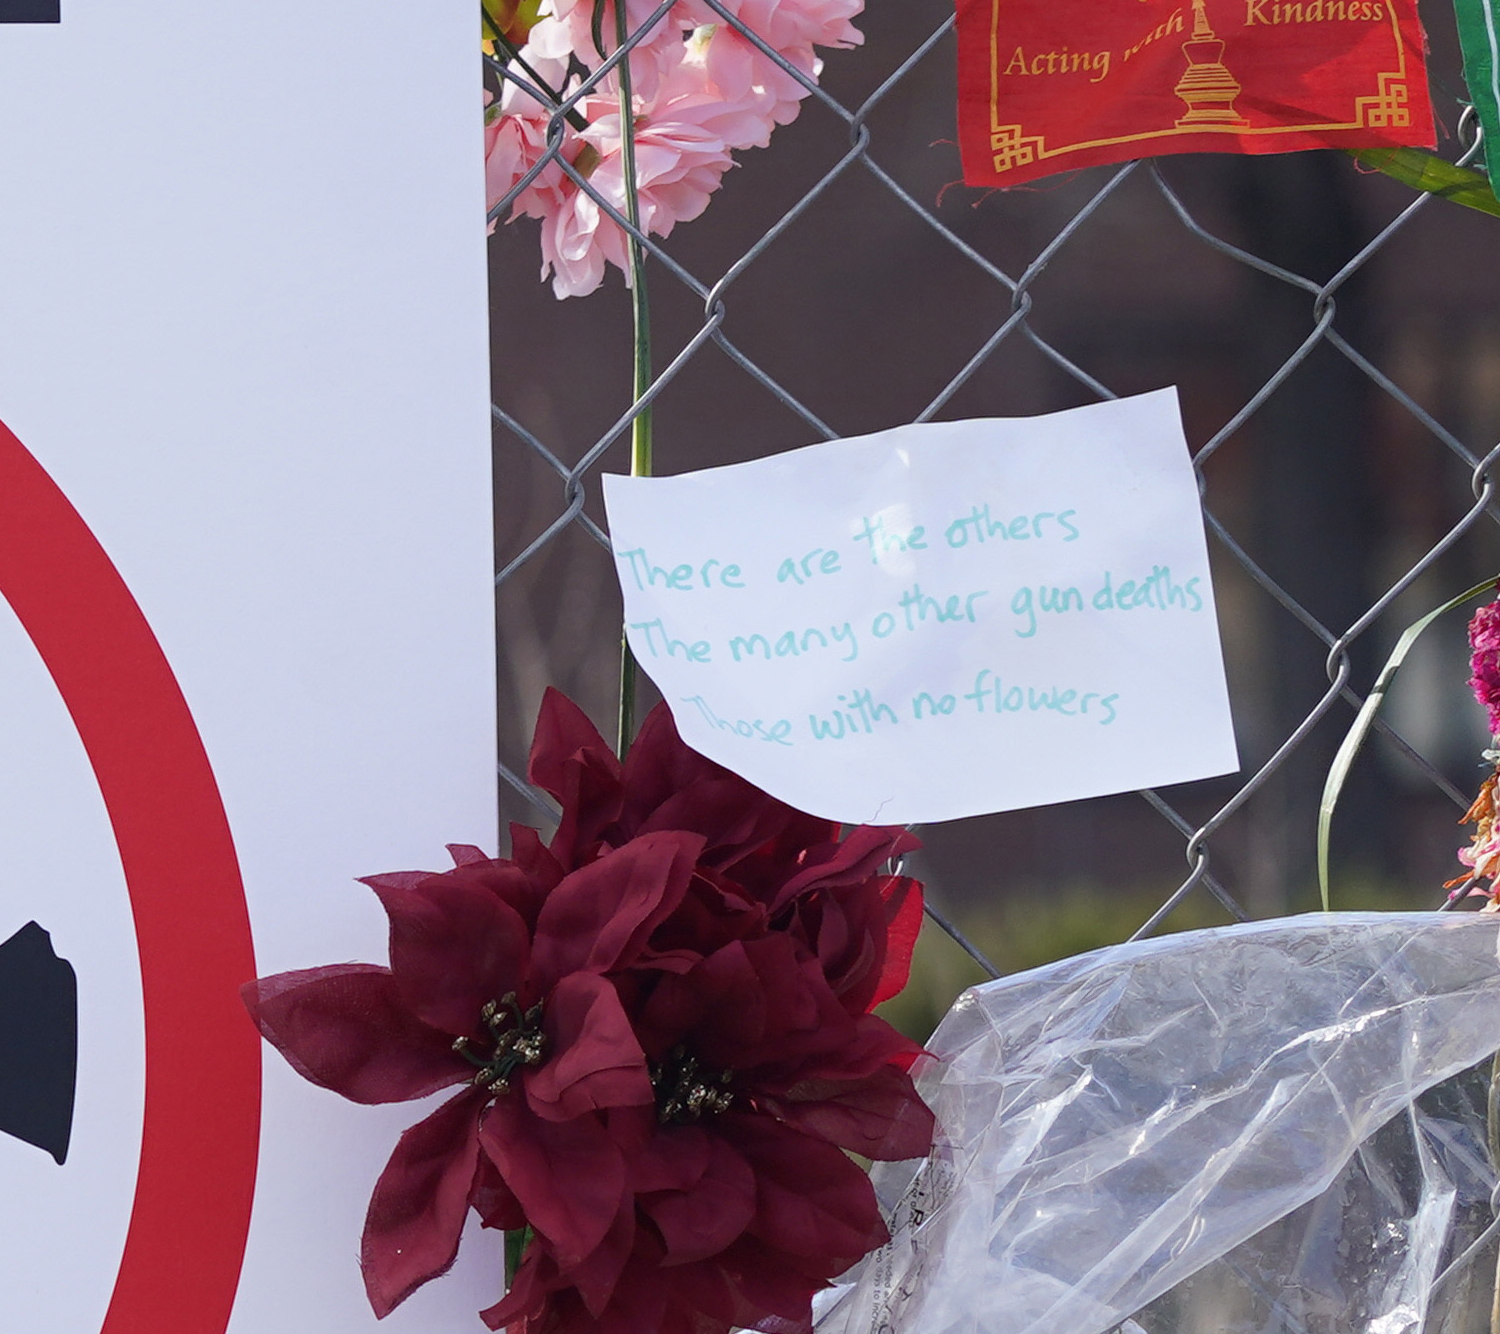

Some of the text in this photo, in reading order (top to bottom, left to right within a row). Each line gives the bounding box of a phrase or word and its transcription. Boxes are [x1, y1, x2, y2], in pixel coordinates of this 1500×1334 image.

[1003, 46, 1112, 83] Acting
[617, 504, 1079, 591] There are the others
[631, 565, 1203, 663] The many other gun deaths
[682, 669, 1119, 746] Those with no flowers
